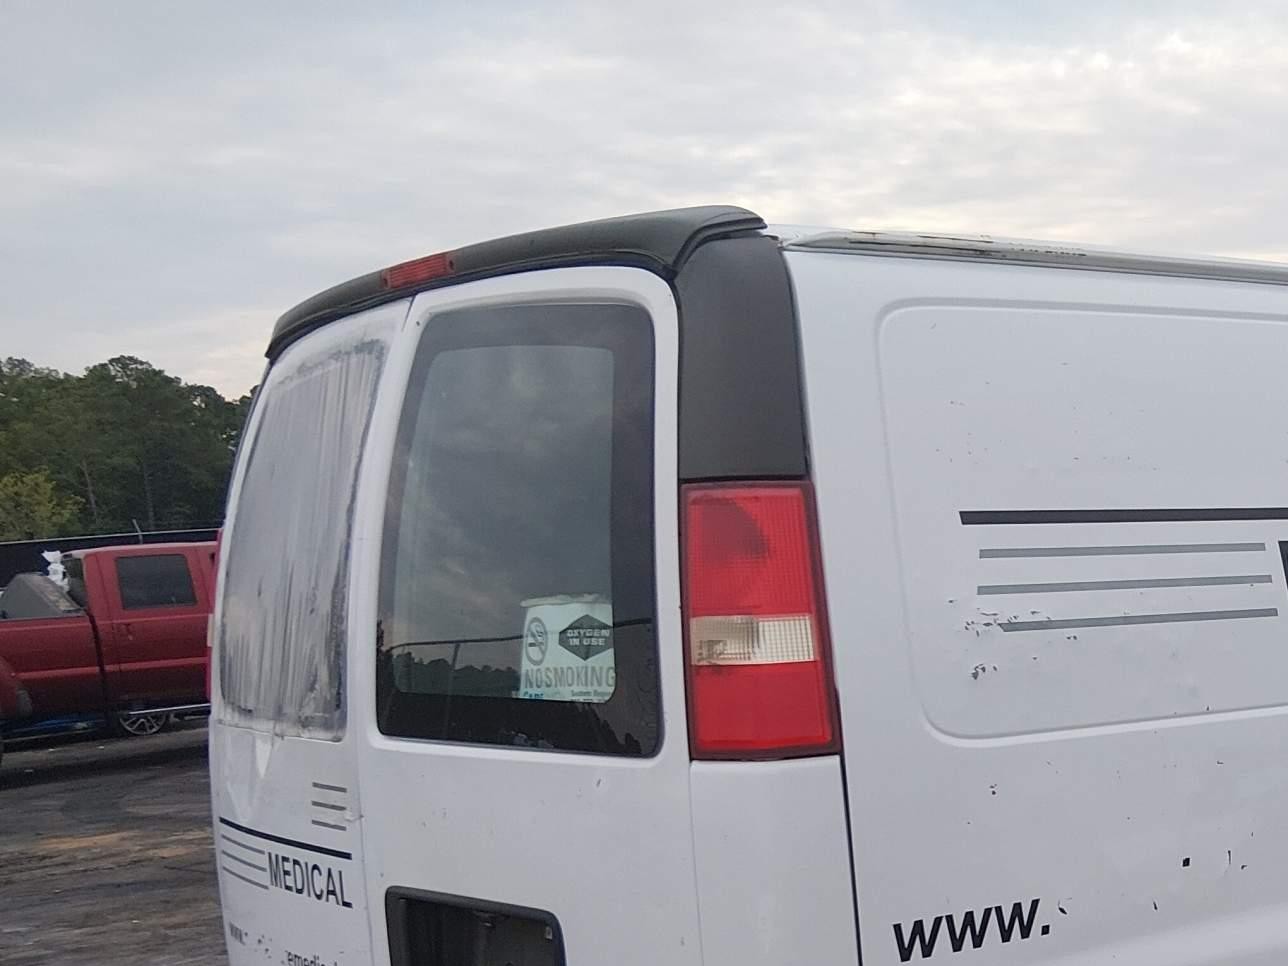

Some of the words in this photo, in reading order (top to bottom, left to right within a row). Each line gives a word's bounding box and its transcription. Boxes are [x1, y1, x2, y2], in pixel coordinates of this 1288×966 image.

[567, 628, 610, 637] OXYGEN
[568, 638, 580, 646] IN
[583, 638, 605, 646] USE
[267, 851, 353, 909] MEDICAL
[893, 898, 1051, 963] www.
